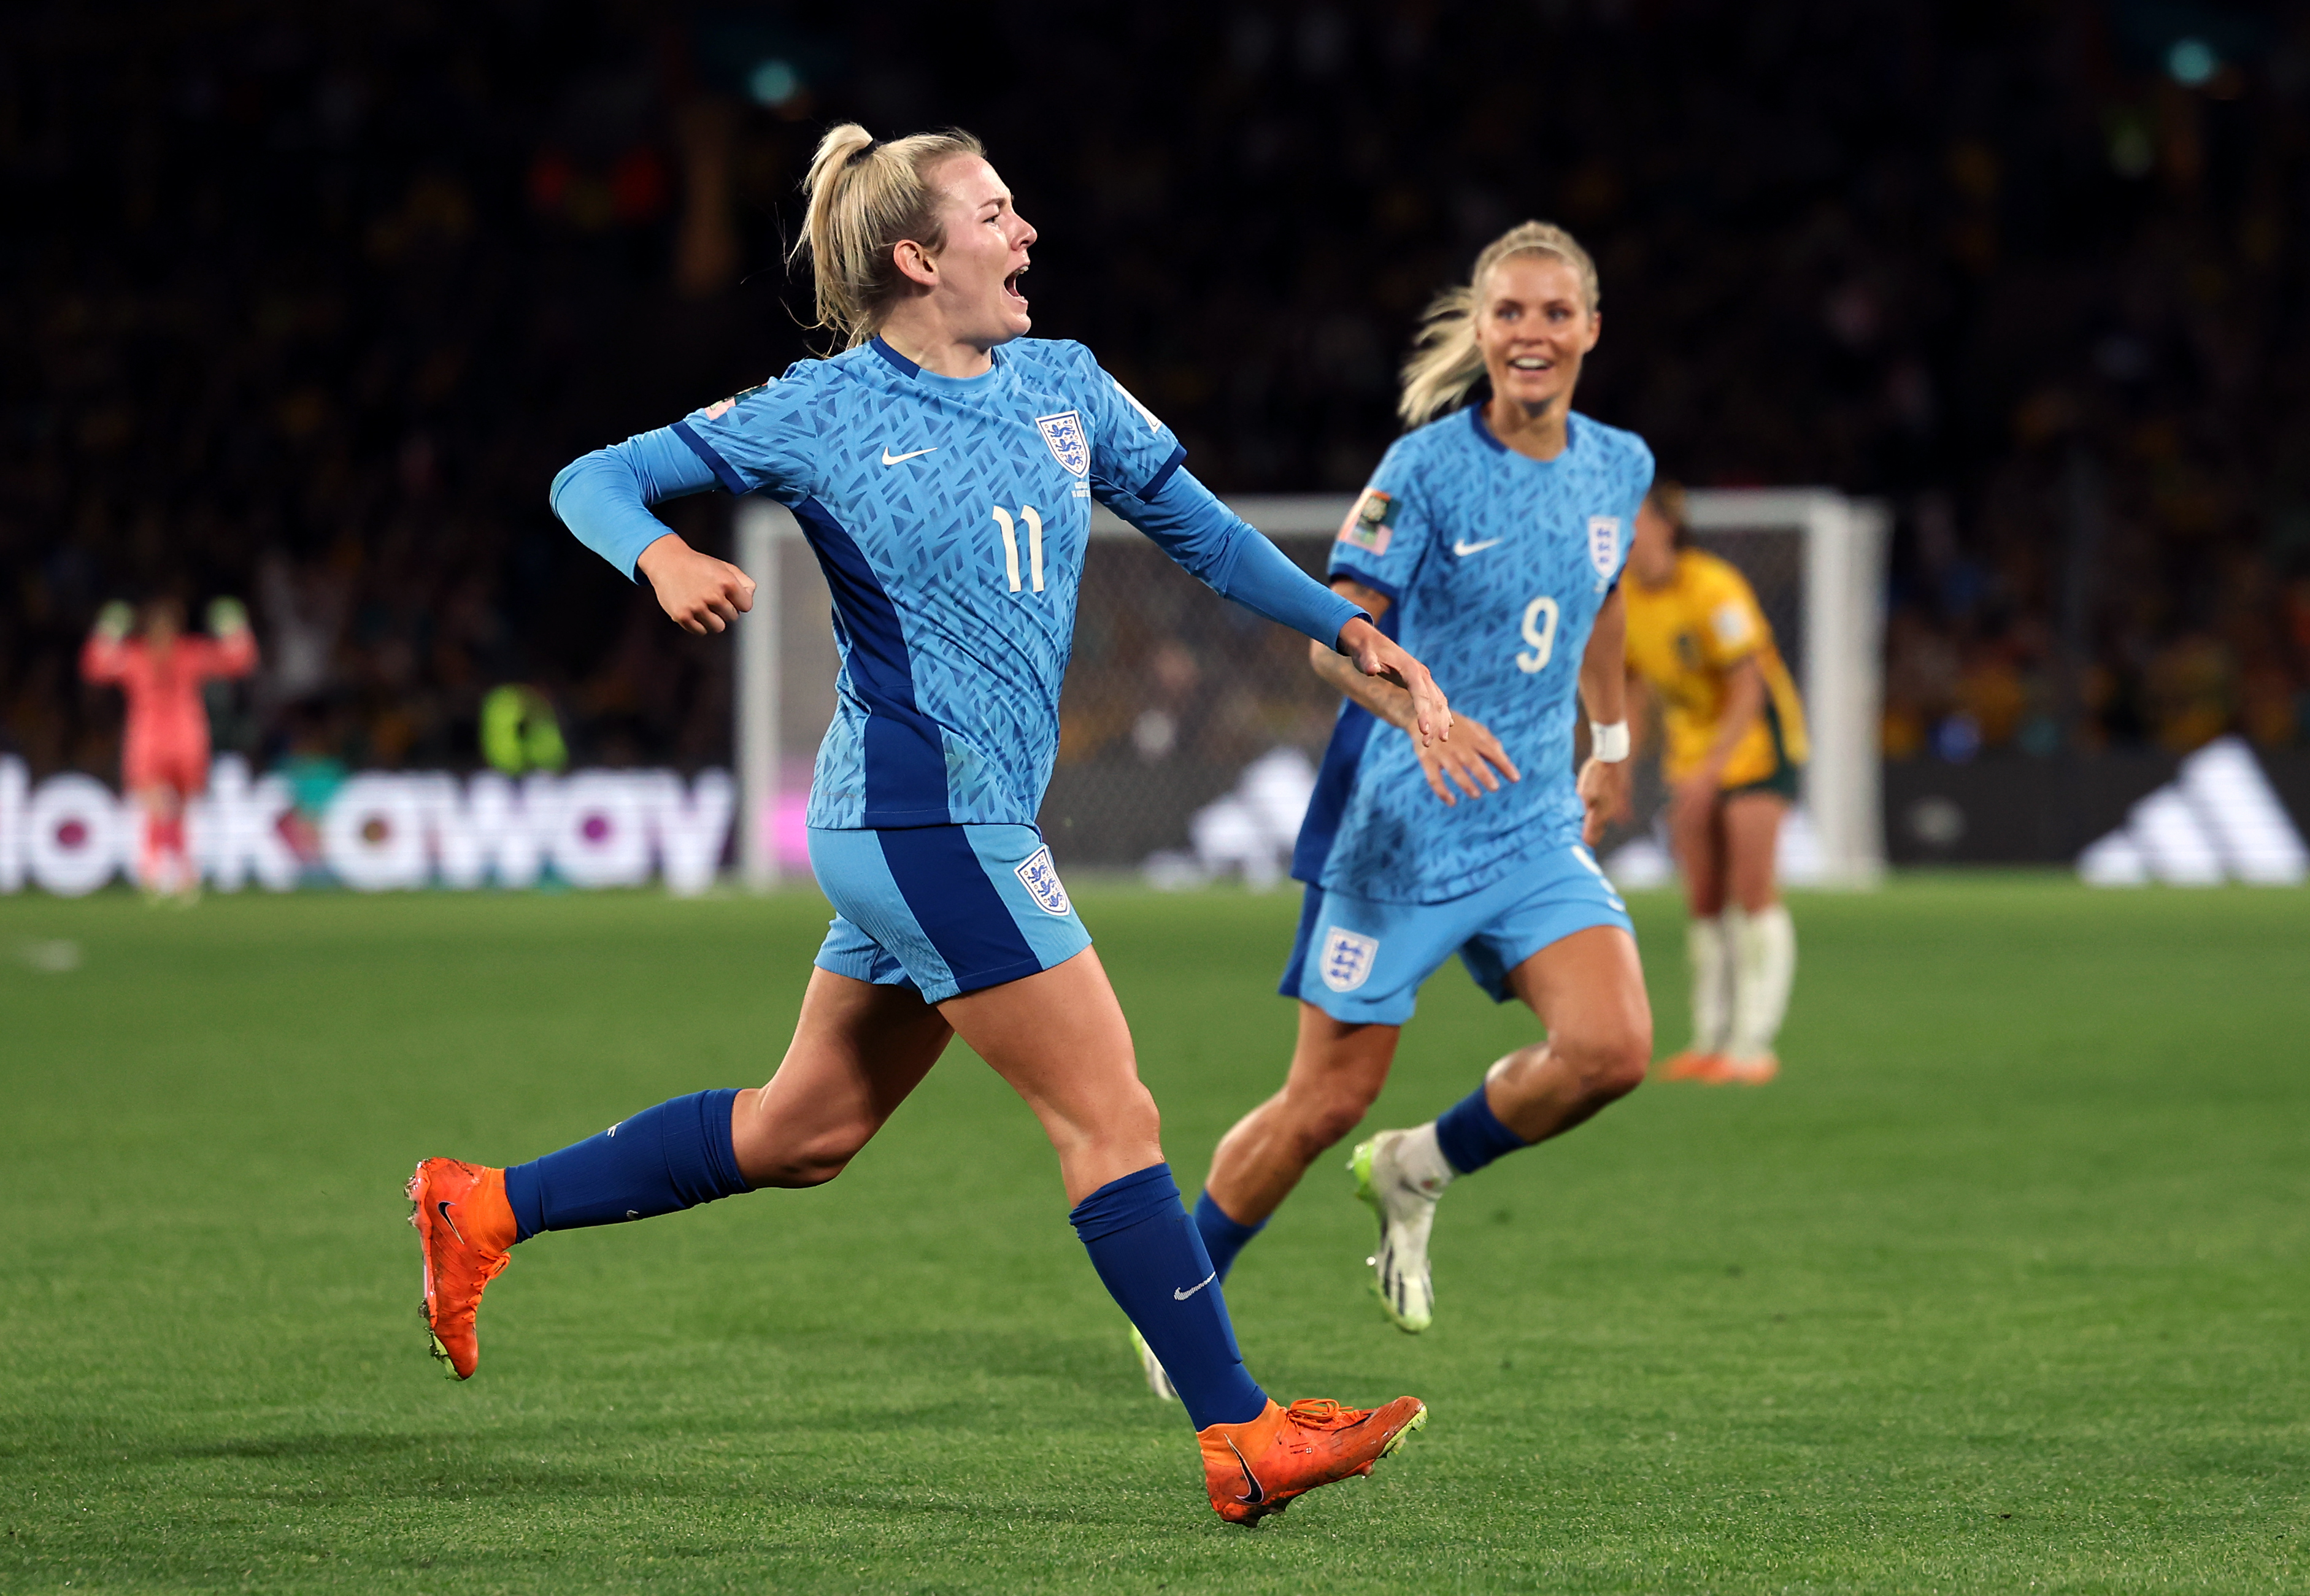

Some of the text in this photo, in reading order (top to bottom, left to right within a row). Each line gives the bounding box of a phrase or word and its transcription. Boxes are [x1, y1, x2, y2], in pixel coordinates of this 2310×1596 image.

[992, 505, 1044, 593] 11
[1515, 595, 1559, 674] 9
[322, 770, 734, 897] away
